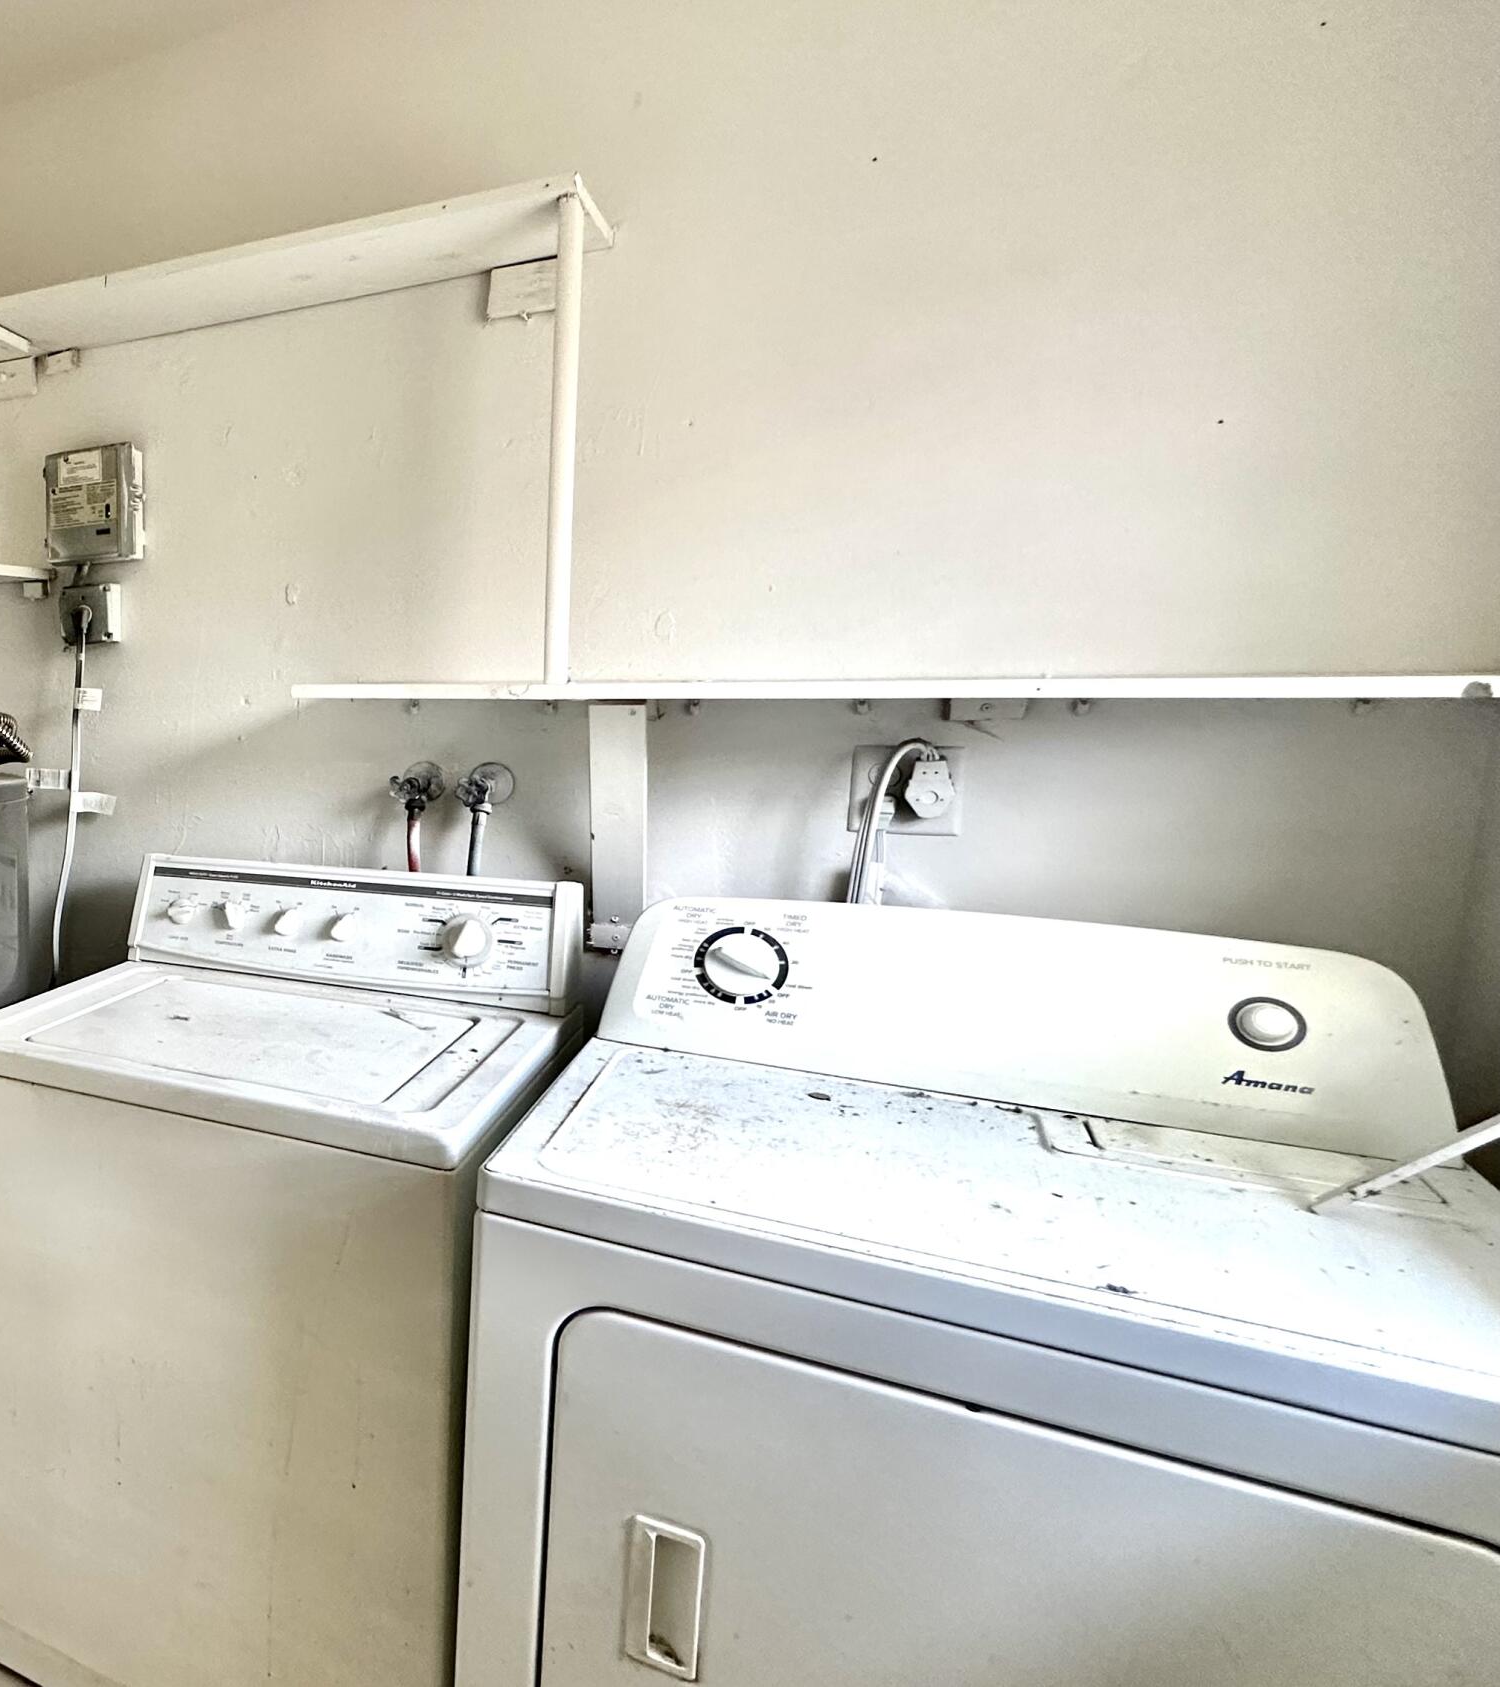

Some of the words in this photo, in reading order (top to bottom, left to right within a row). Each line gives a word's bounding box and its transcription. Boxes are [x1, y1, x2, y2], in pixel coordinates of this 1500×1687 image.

[310, 879, 357, 889] KitchenAid
[673, 905, 716, 914] AUTOMATIC
[783, 913, 807, 921] TIMED
[1222, 957, 1254, 966] PUSH
[1257, 959, 1273, 968] TO
[1275, 961, 1312, 971] START
[645, 994, 690, 1006] AUTOMATIC
[765, 1010, 779, 1018] AIR
[780, 1012, 797, 1020] DRY
[1221, 1070, 1315, 1094] Amana
